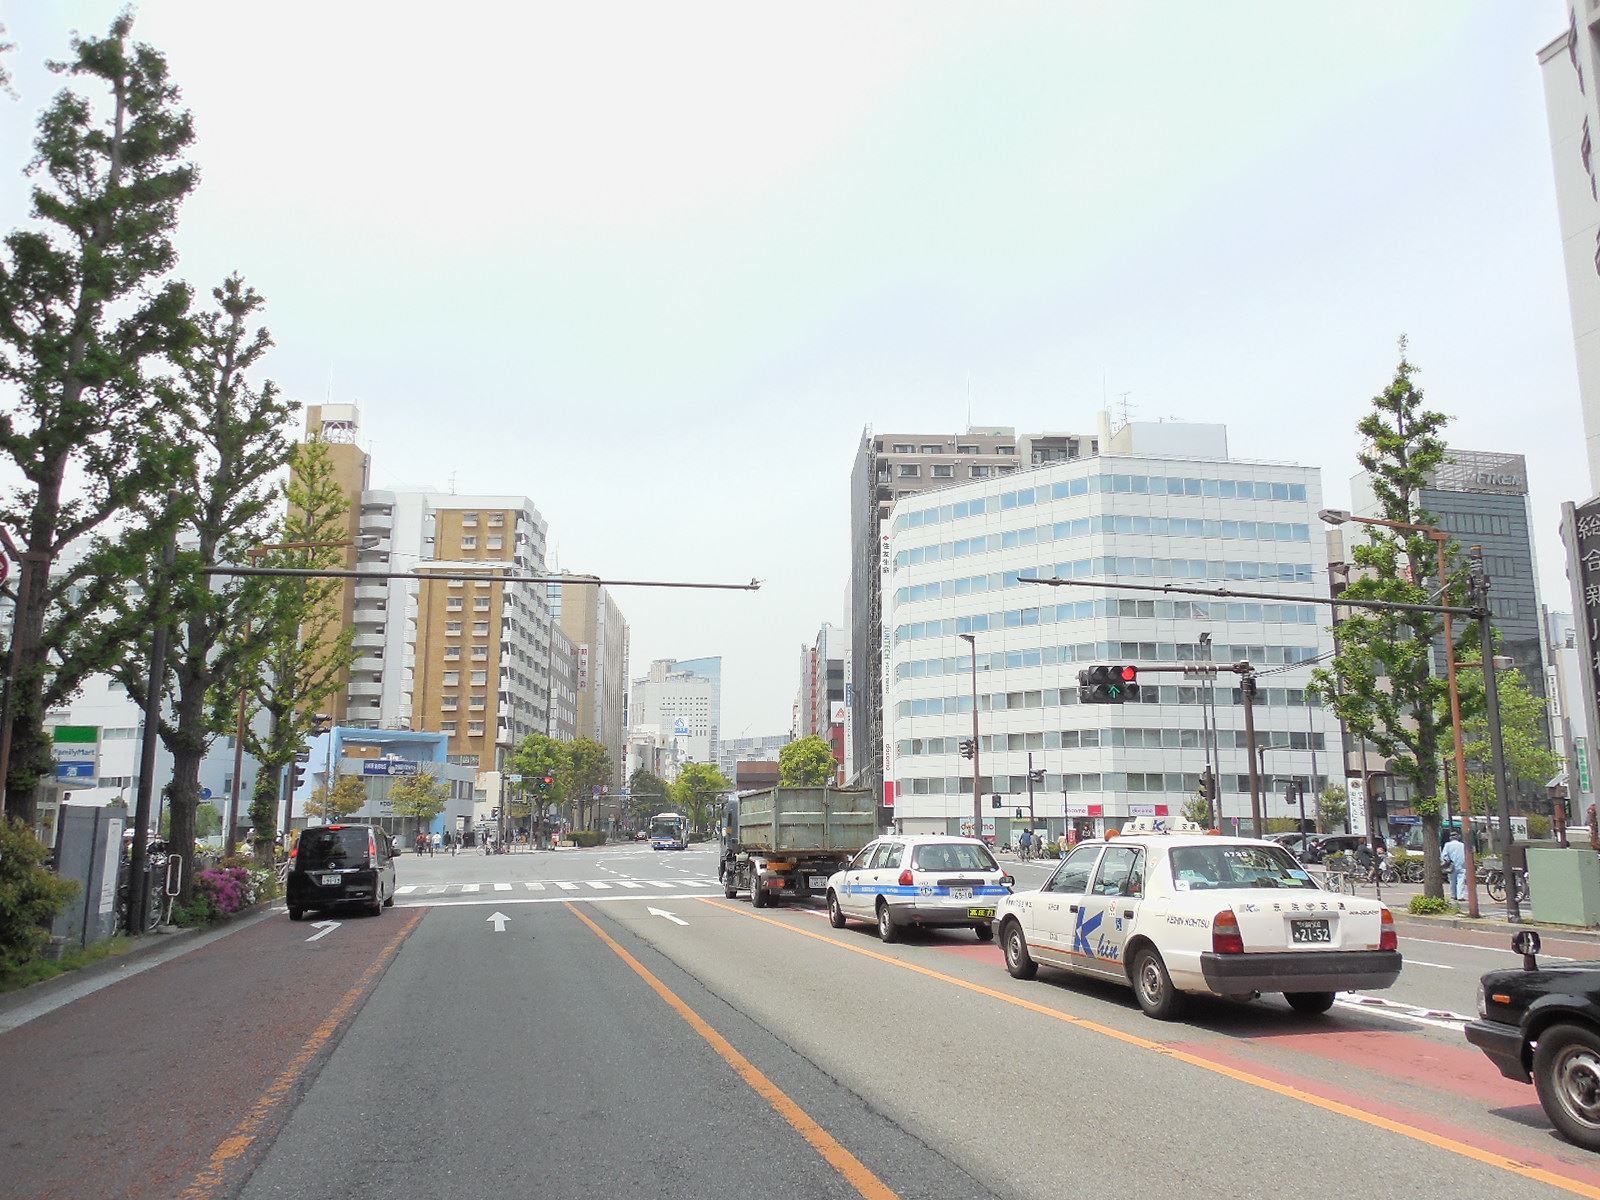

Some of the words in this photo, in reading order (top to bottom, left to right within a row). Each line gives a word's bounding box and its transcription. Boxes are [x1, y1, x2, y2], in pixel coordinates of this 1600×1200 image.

[882, 543, 890, 573] 住友生命
[54, 748, 96, 757] FamilyMart
[1301, 928, 1330, 941] 21-52
